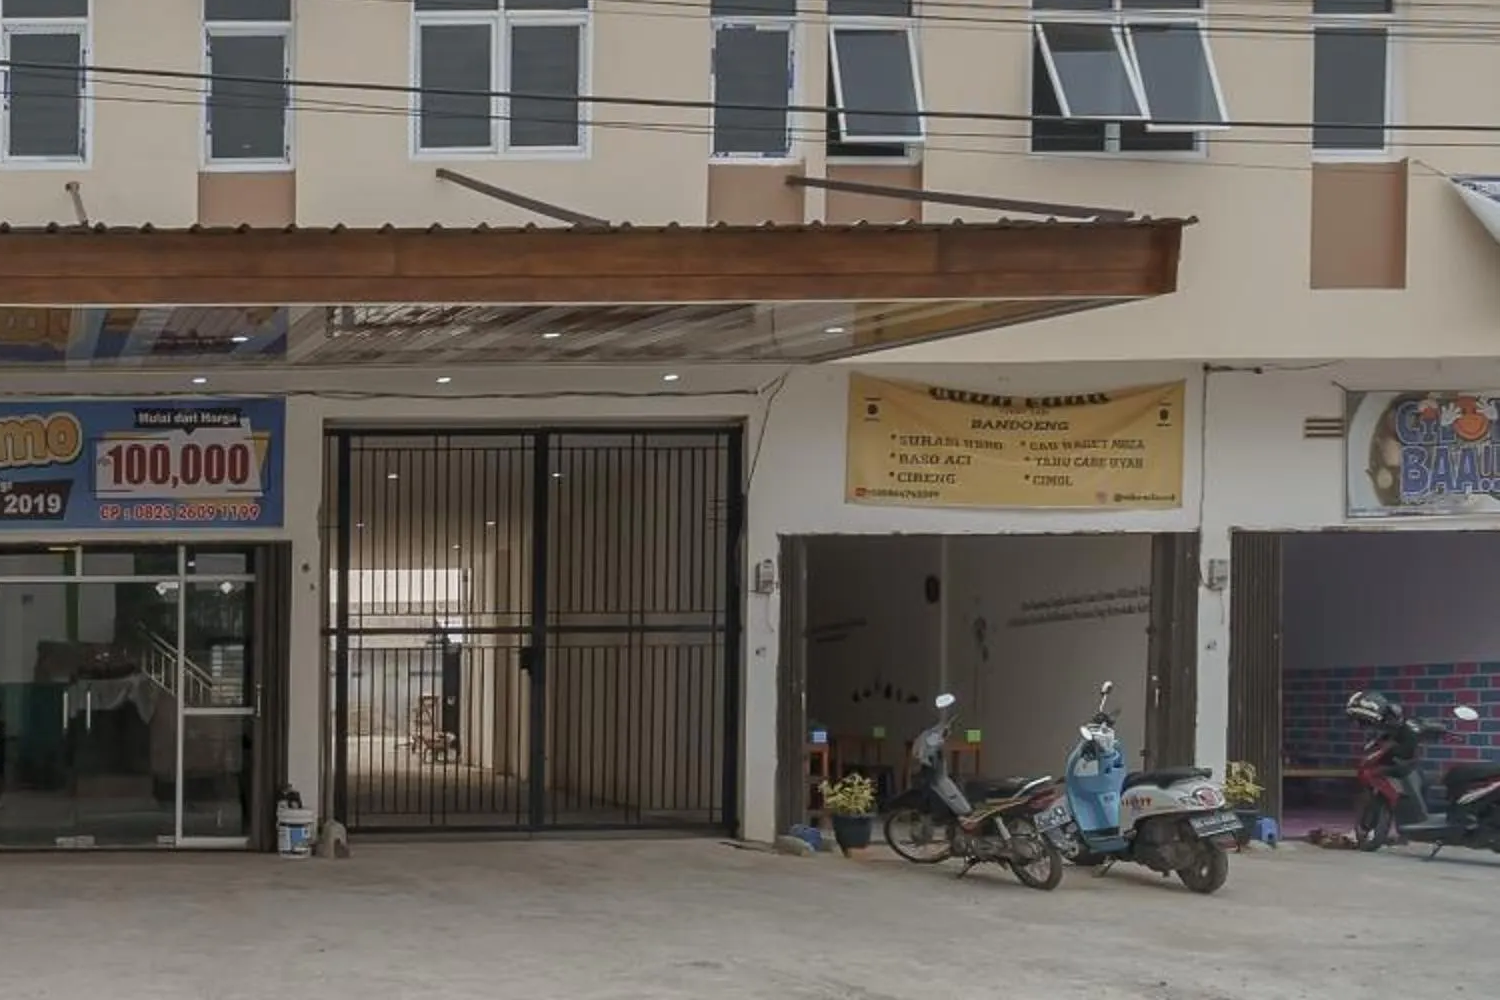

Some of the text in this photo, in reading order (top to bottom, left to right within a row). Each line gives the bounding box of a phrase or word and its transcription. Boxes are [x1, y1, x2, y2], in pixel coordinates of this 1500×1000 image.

[200, 412, 238, 426] Harga
[107, 444, 249, 488] 100,000
[4, 494, 62, 515] 2019
